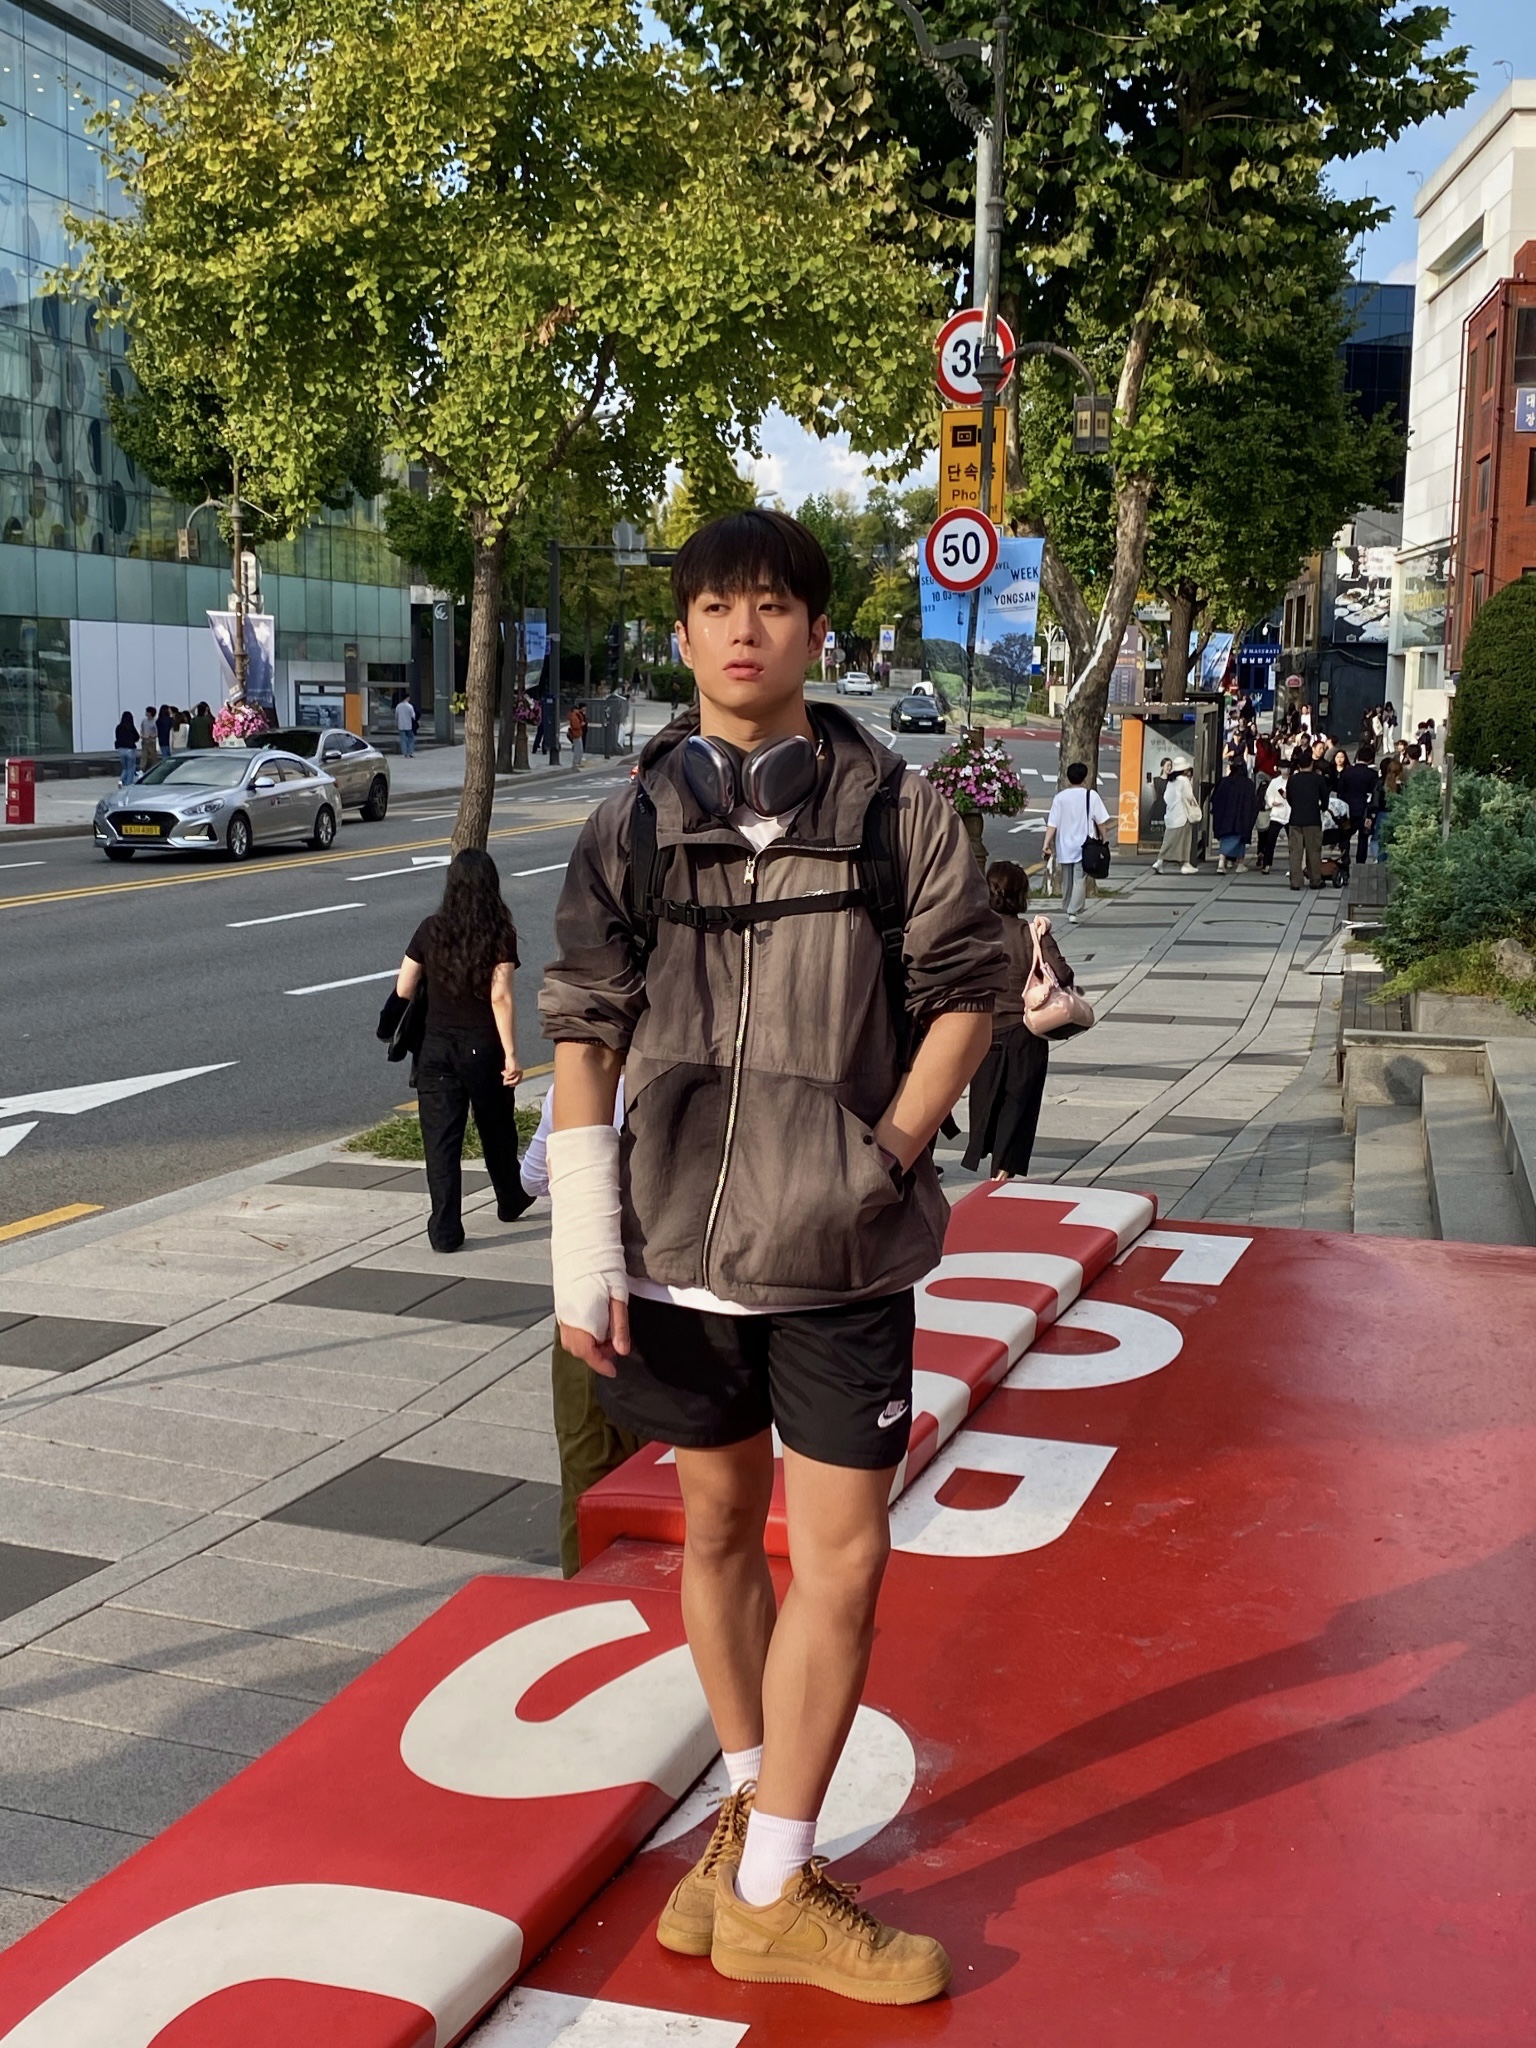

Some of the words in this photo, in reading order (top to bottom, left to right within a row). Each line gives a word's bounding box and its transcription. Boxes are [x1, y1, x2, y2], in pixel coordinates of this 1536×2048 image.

[952, 339, 981, 378] 3
[952, 489, 980, 501] Pho
[942, 531, 981, 567] 50
[1010, 566, 1039, 581] WEEK
[984, 586, 992, 595] IN
[994, 591, 1036, 606] YONGSAN
